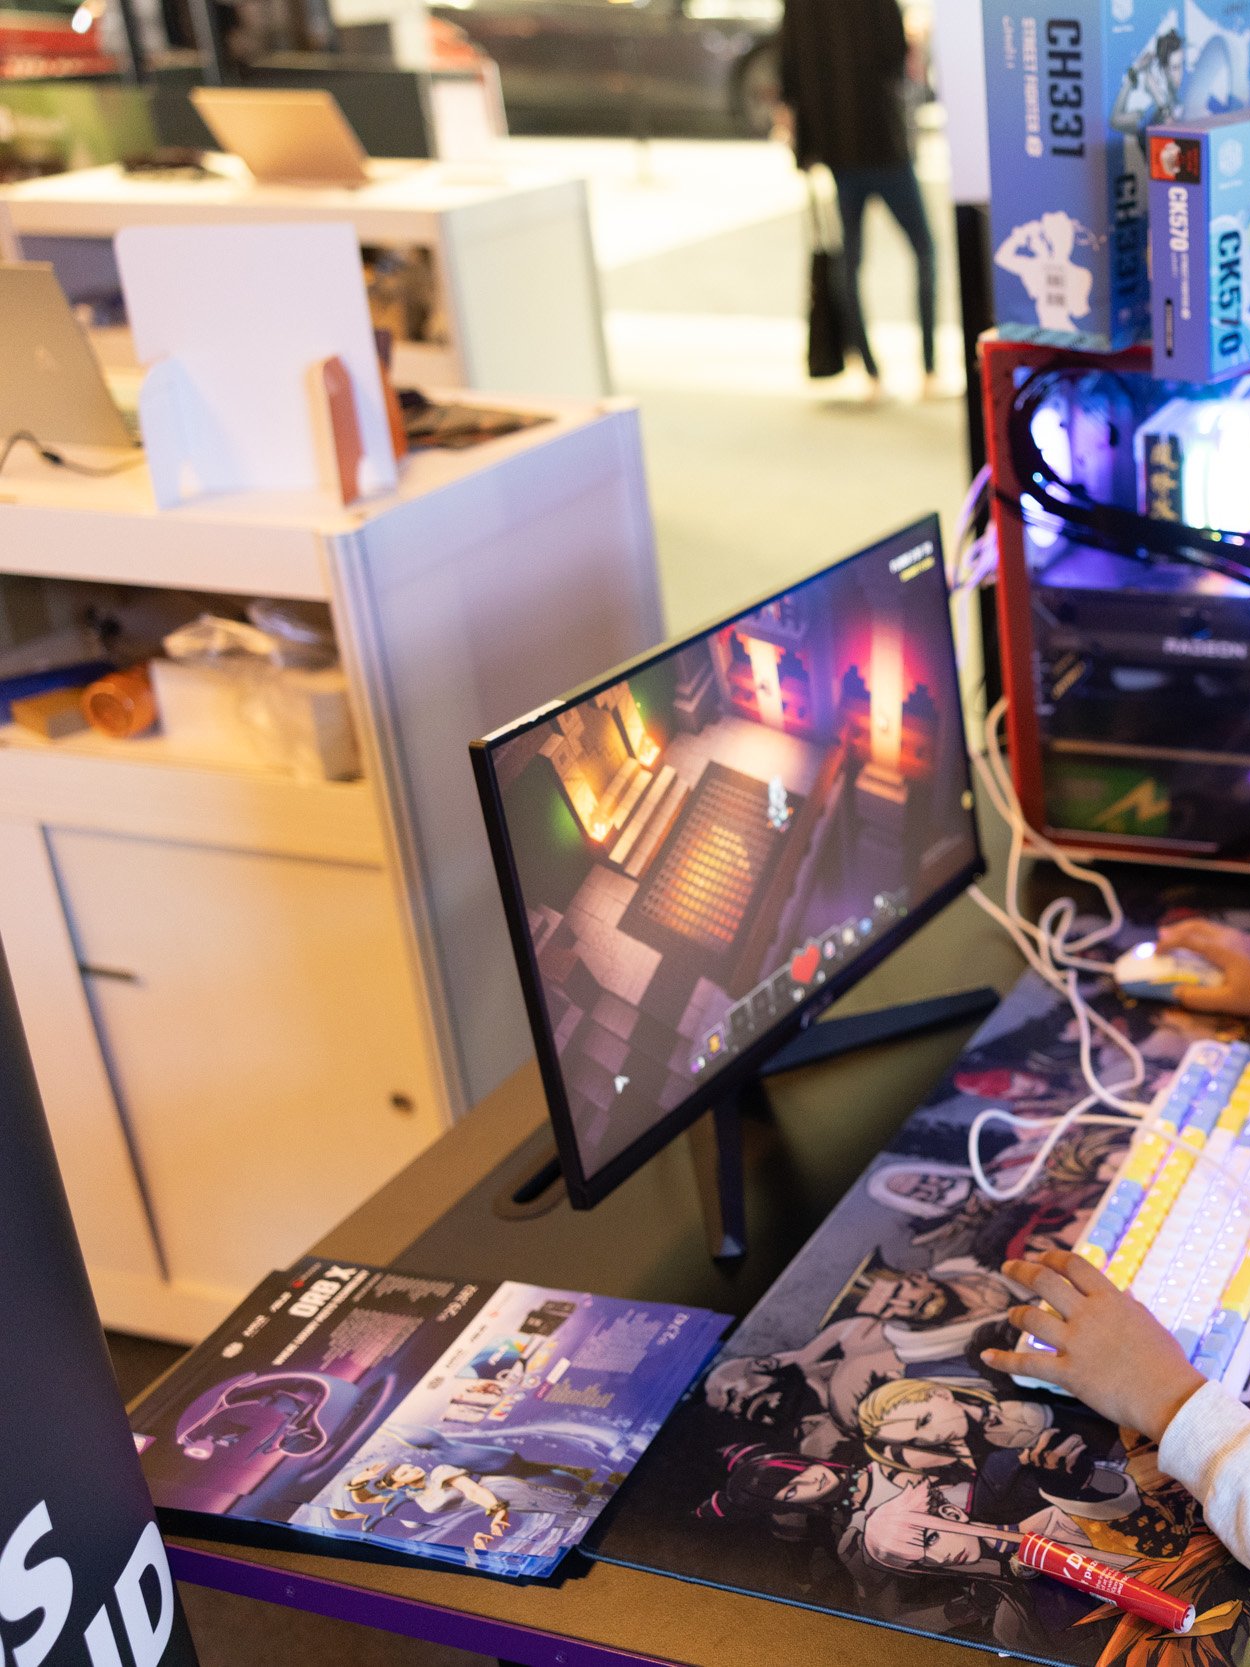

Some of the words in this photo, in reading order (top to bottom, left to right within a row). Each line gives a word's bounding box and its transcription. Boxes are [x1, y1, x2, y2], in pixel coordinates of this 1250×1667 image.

[1047, 18, 1086, 160] CH331
[1167, 186, 1190, 252] CK570
[1217, 230, 1242, 357] CK570
[288, 1278, 342, 1318] ORB
[323, 1264, 358, 1282] X
